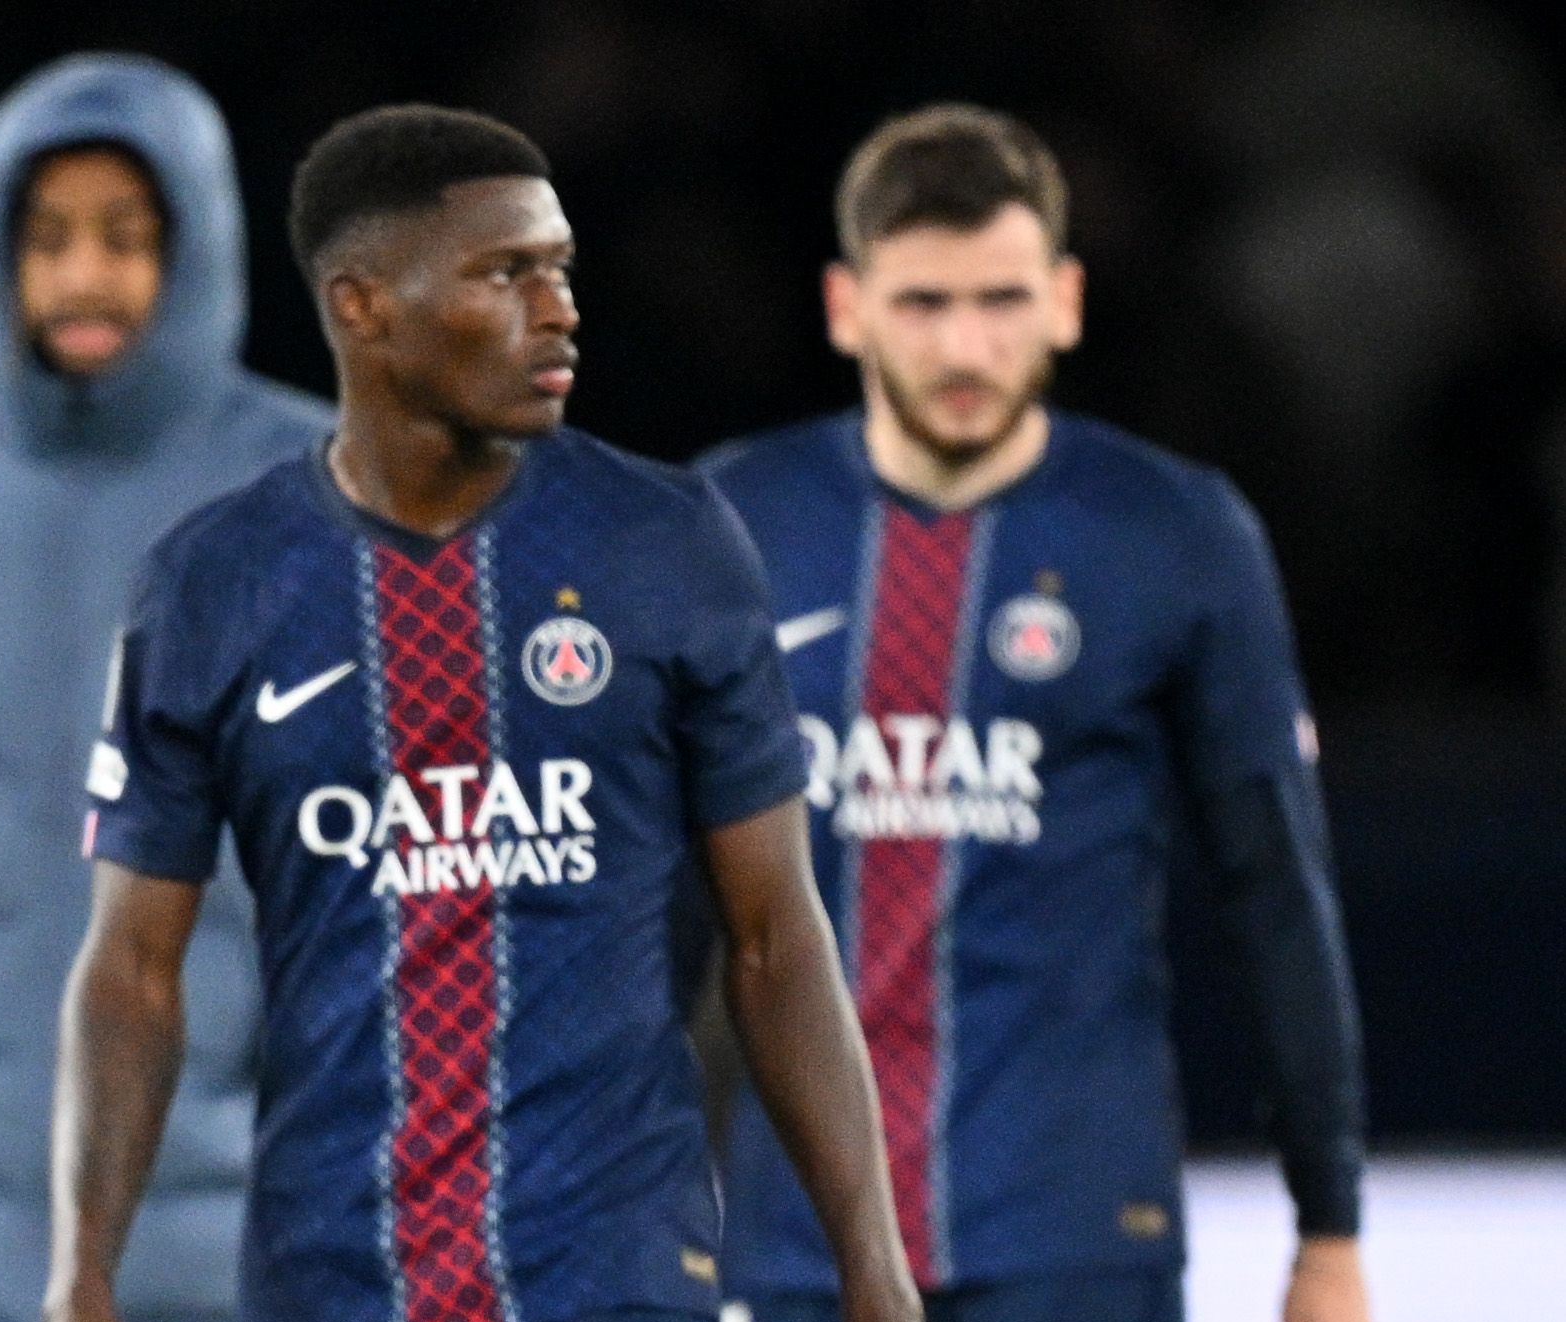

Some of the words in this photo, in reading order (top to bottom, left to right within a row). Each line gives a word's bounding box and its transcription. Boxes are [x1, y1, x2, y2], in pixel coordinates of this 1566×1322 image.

[800, 713, 1044, 810] QATAR
[298, 758, 596, 868] QATAR
[371, 835, 598, 896] AIRWAYS
